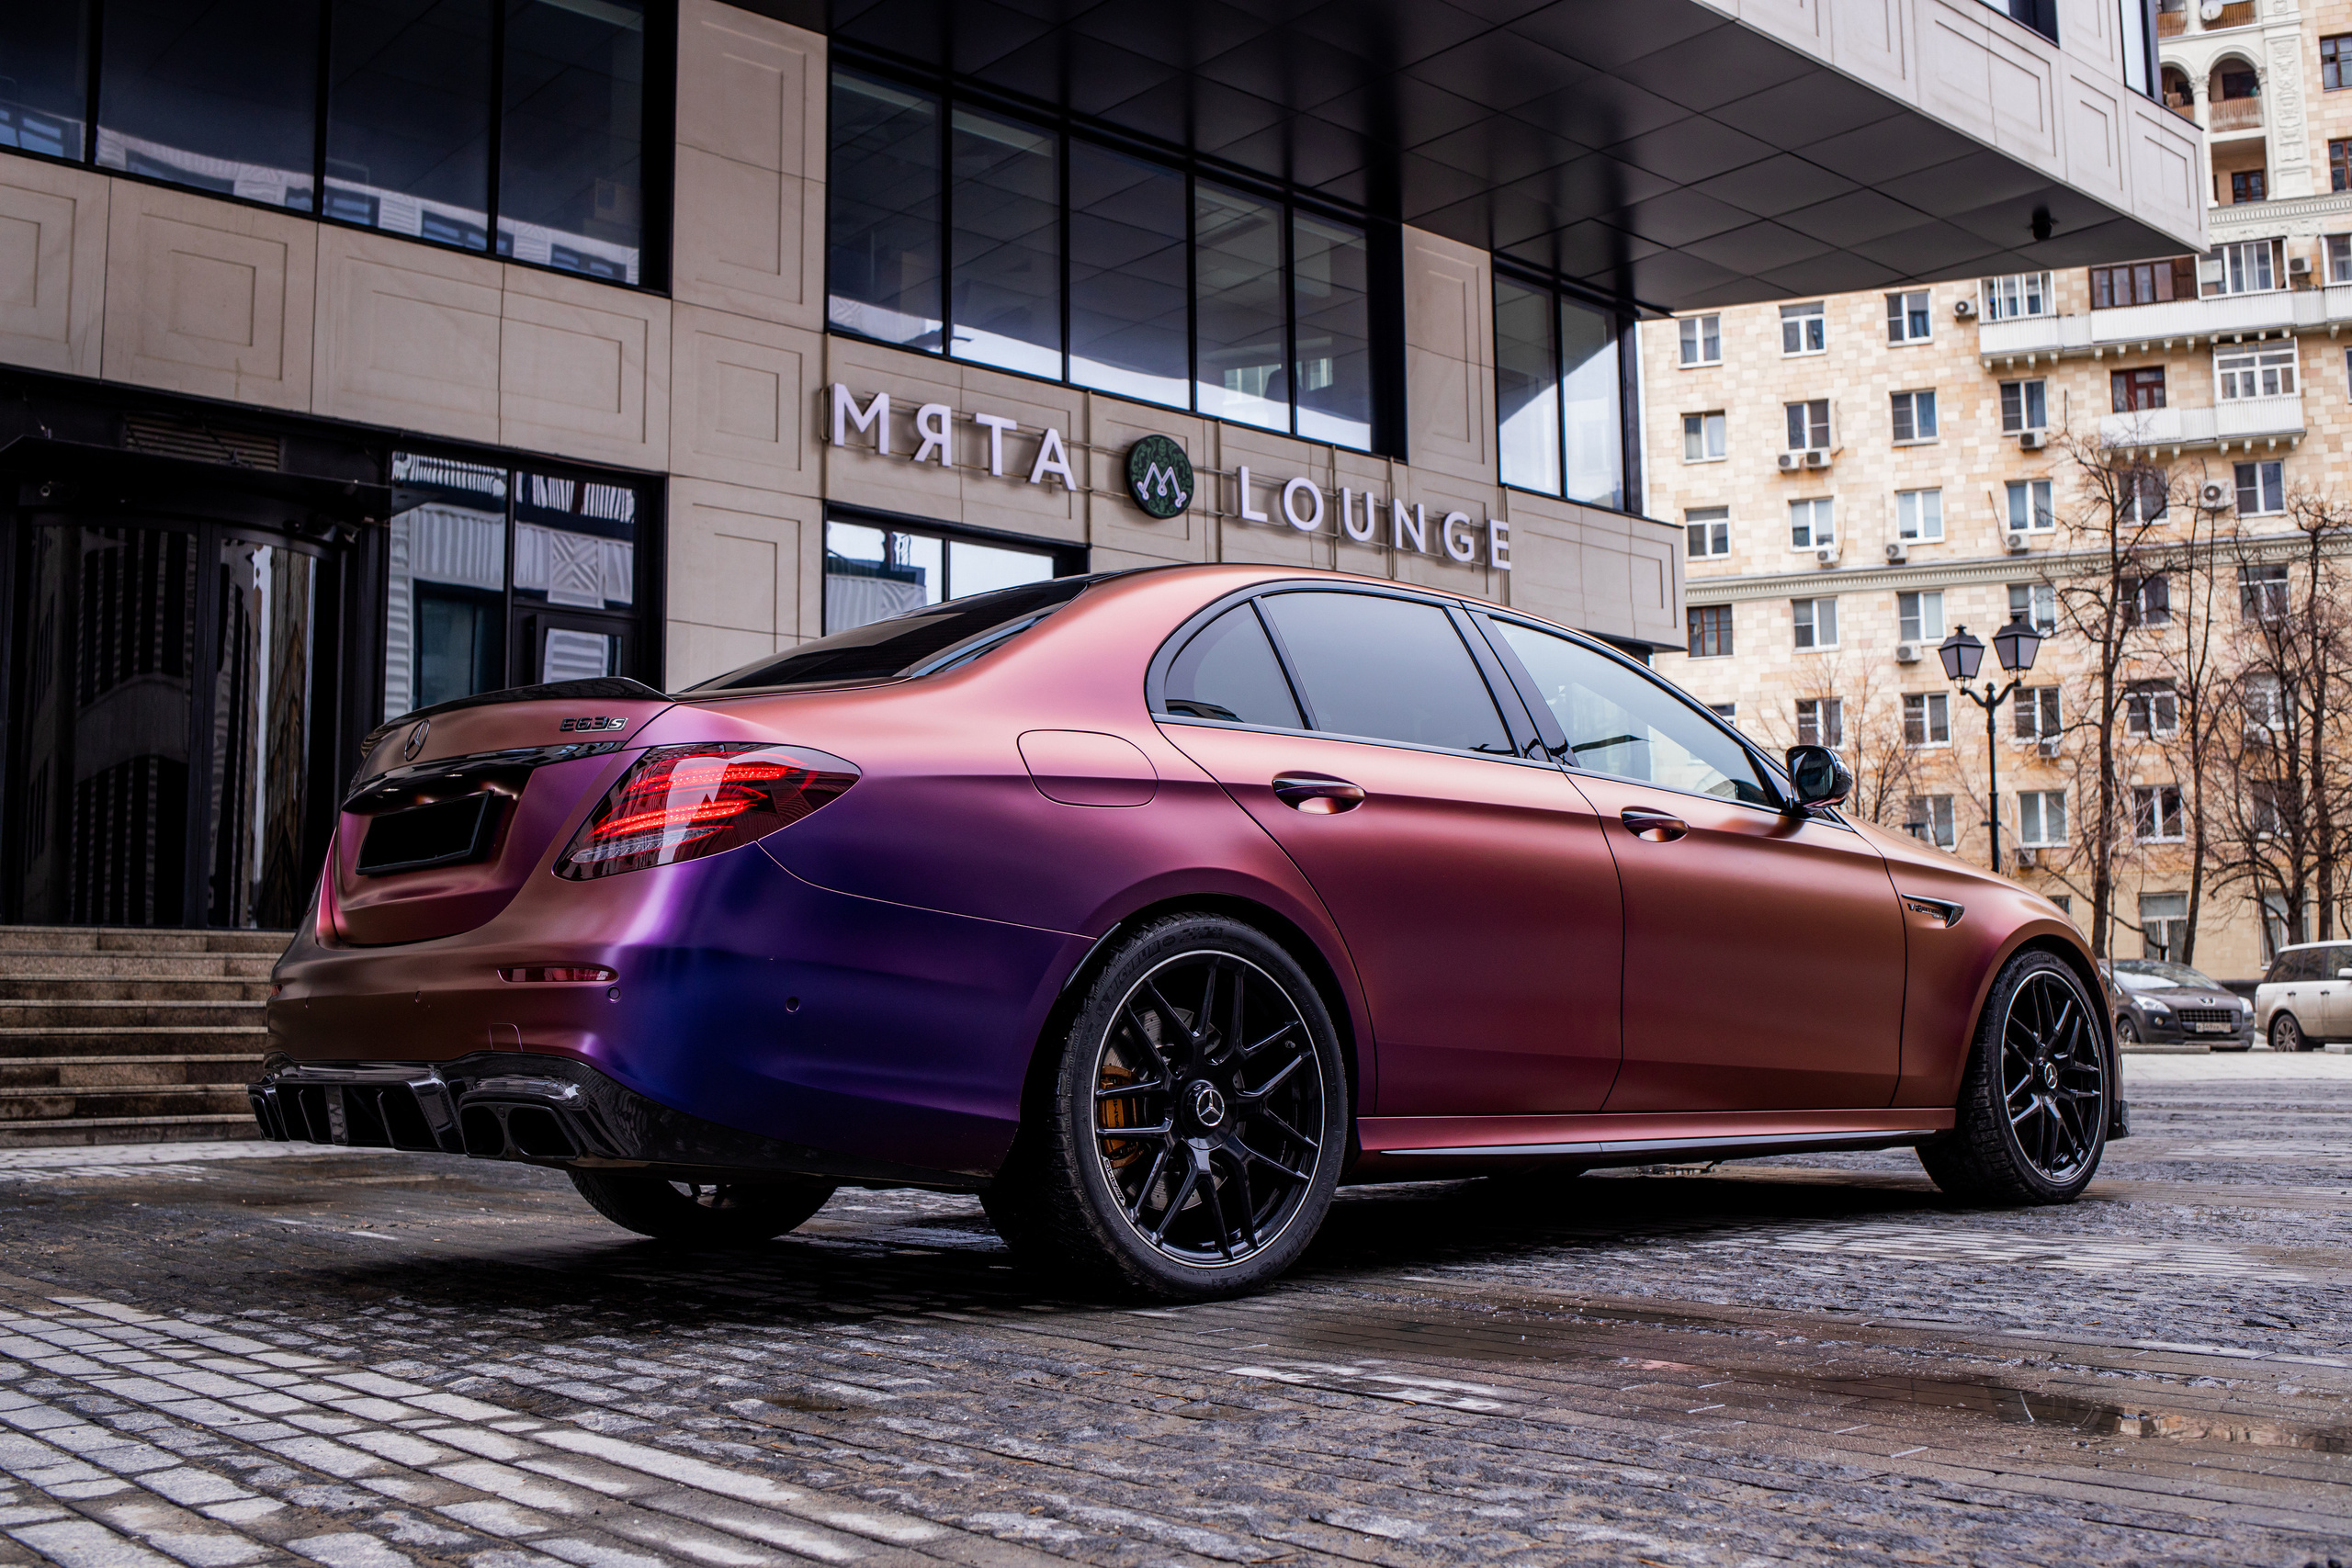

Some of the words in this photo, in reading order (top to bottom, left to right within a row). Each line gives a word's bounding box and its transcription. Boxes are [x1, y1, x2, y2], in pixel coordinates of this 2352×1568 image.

[831, 382, 1077, 491] МЯТА
[1237, 465, 1511, 570] LOUNGE
[1105, 940, 1161, 1000] MICHELIN
